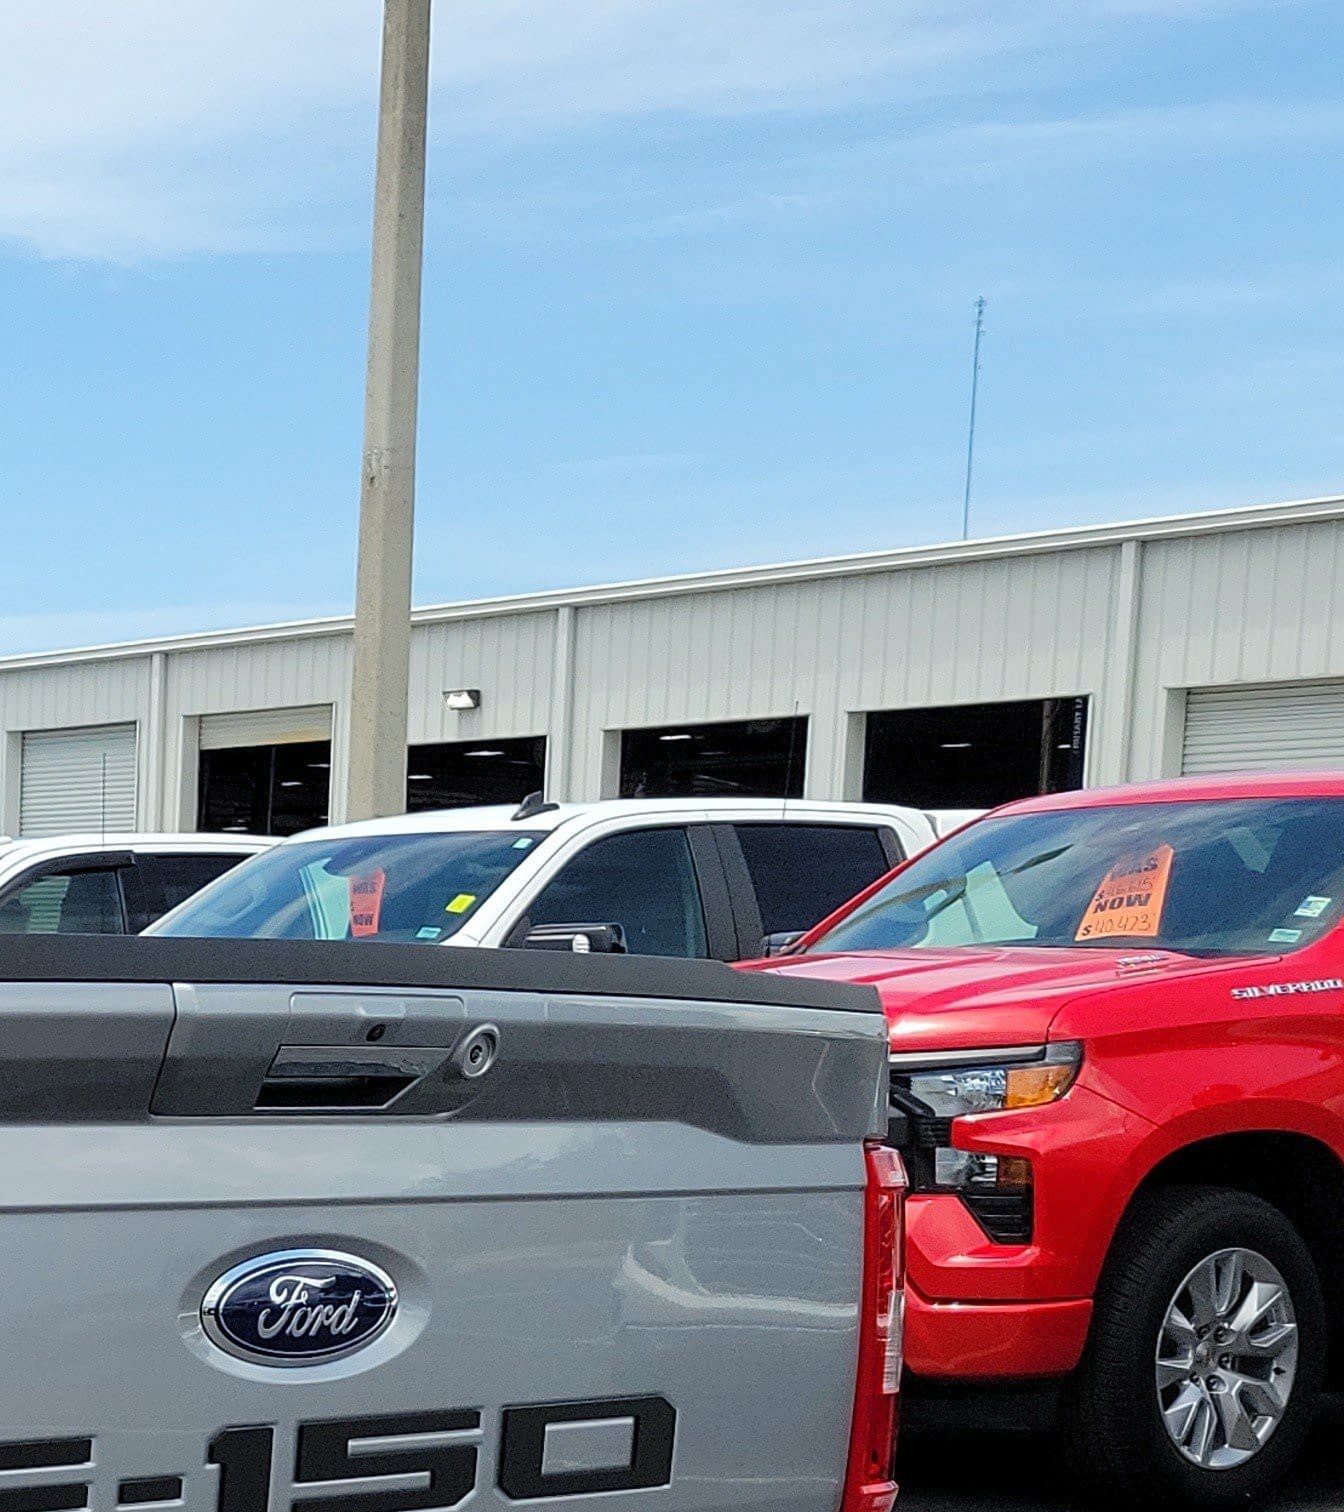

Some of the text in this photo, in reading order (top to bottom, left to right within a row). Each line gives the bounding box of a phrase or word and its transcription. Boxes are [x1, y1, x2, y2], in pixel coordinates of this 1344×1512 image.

[1093, 893, 1152, 914] NOW
[1230, 978, 1343, 1000] SILVERADO
[257, 1274, 362, 1340] Ford
